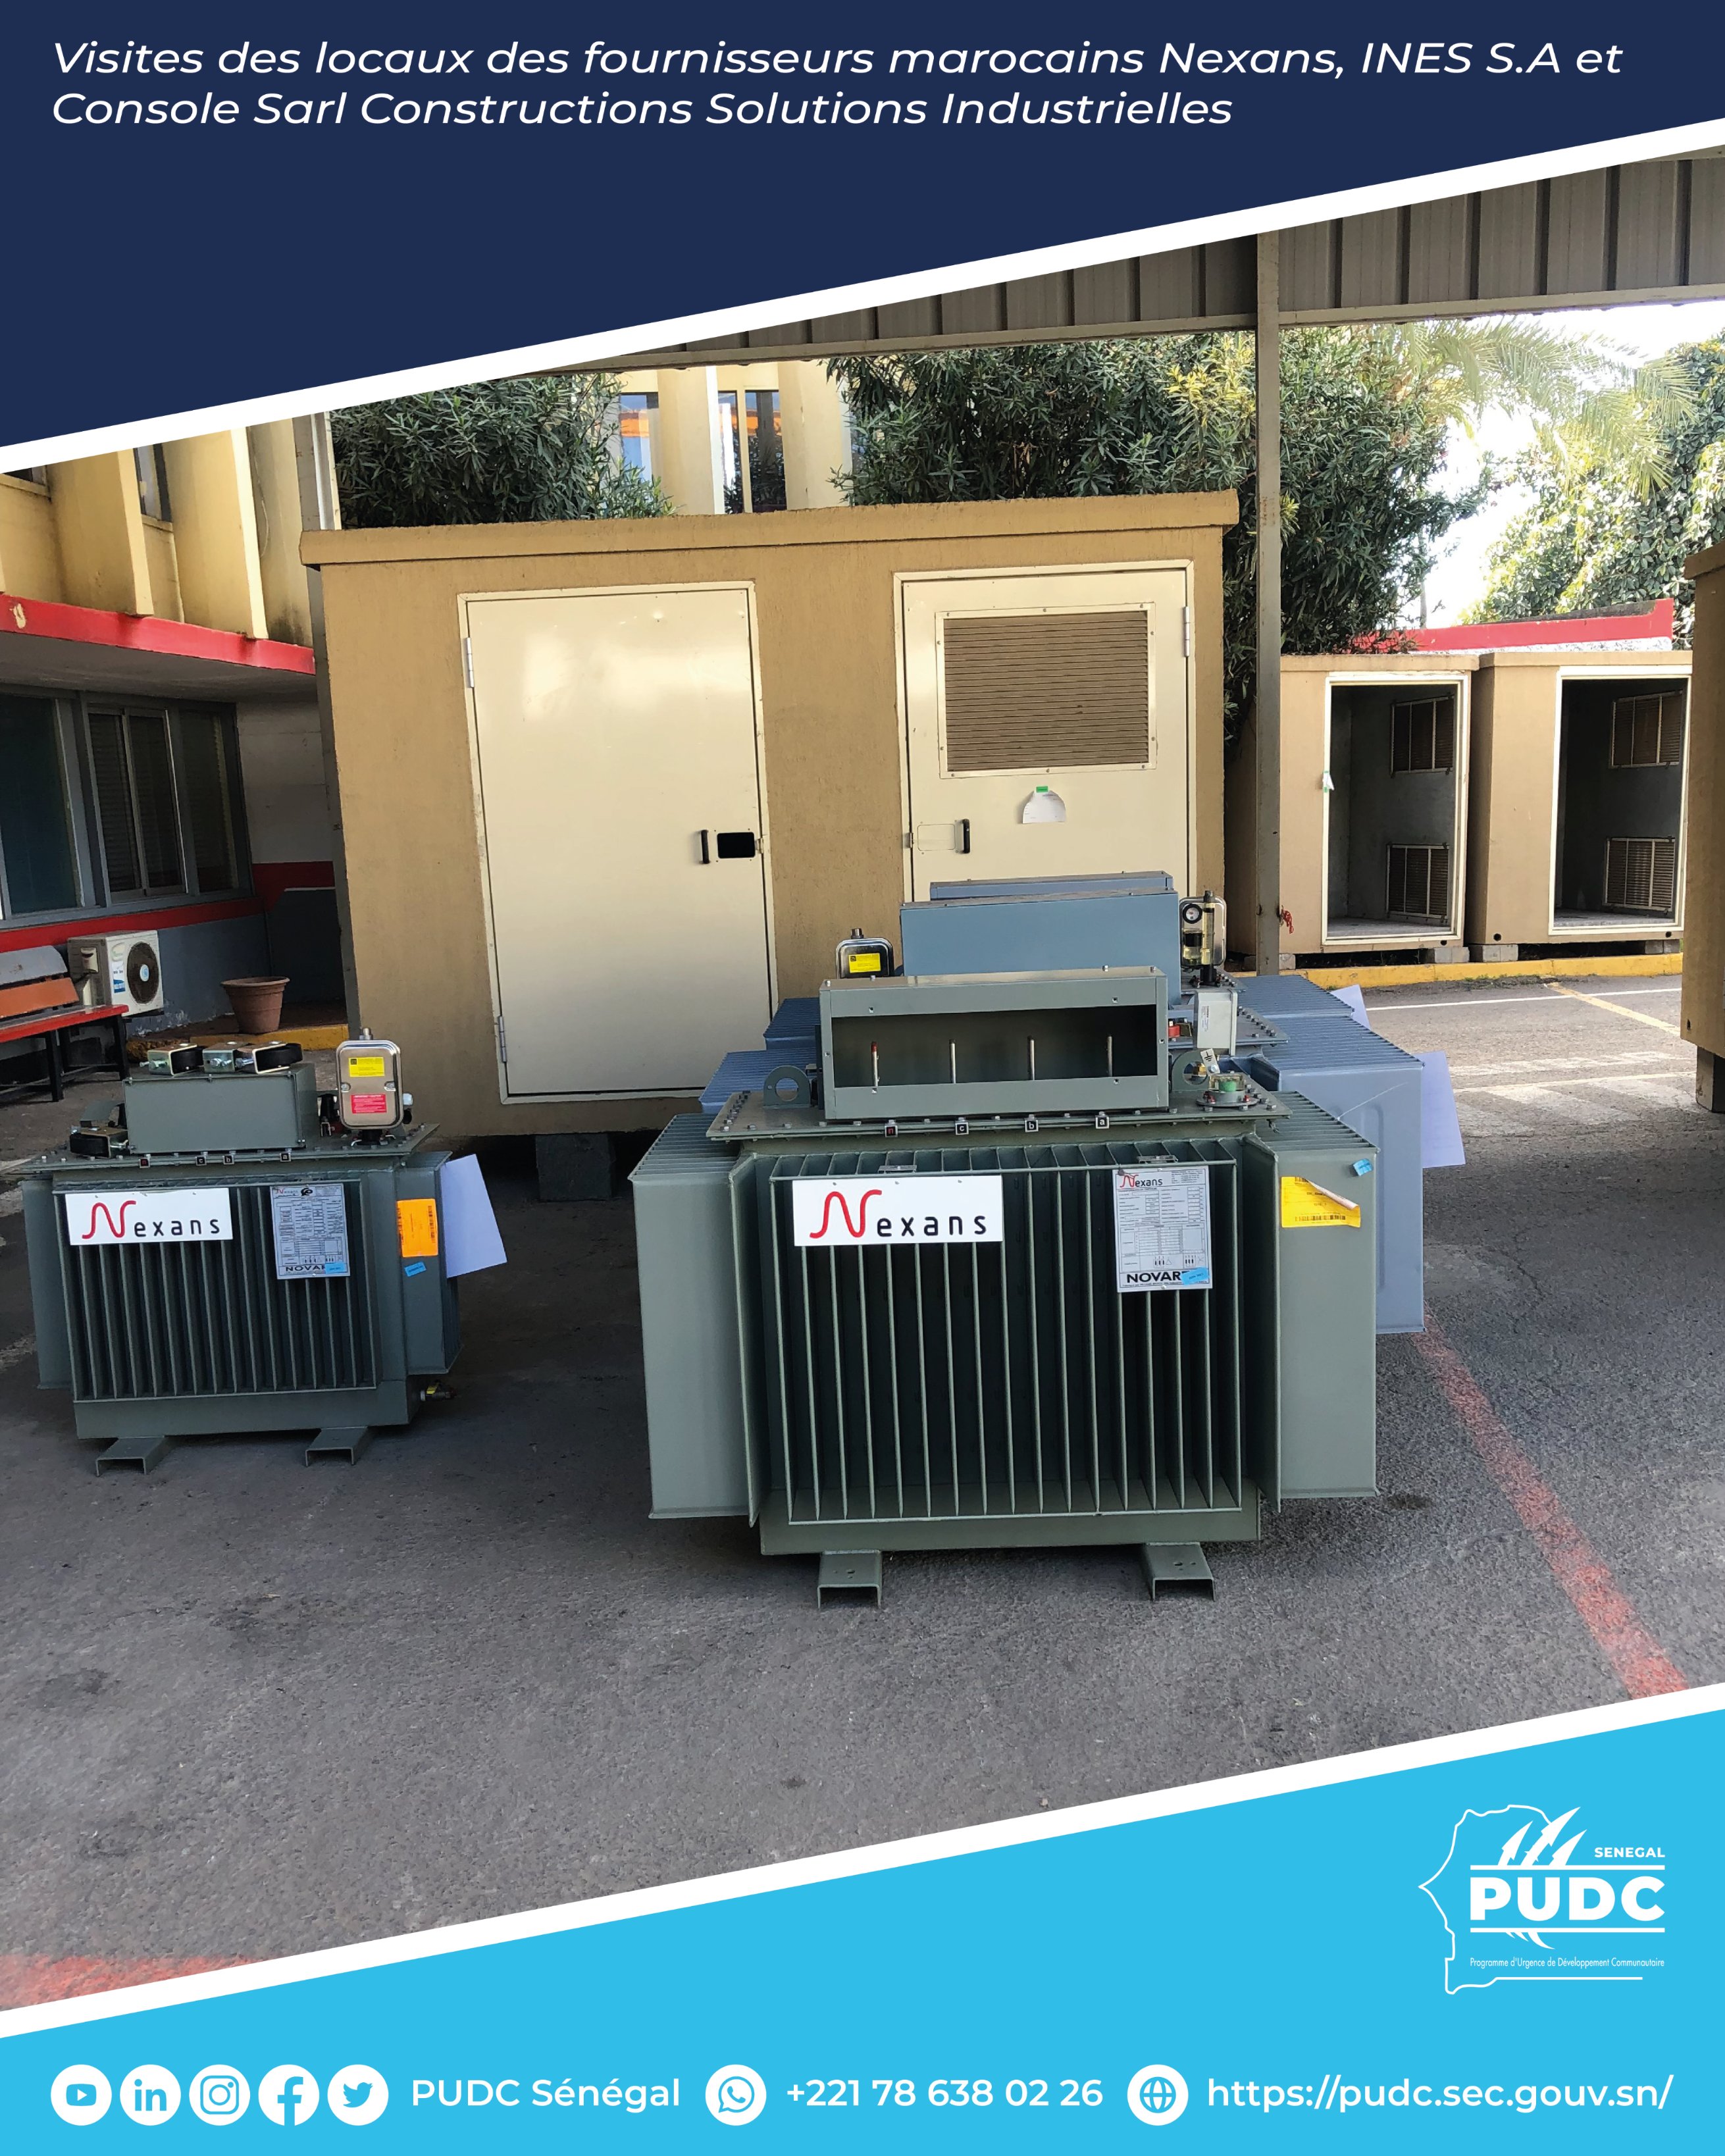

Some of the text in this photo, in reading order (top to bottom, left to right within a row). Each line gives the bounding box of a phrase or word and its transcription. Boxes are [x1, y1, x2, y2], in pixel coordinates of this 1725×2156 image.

[1120, 1175, 1162, 1188] Nexans
[82, 1200, 220, 1239] Nexans
[810, 1189, 987, 1239] Nexans
[1127, 1270, 1190, 1283] NOVAR
